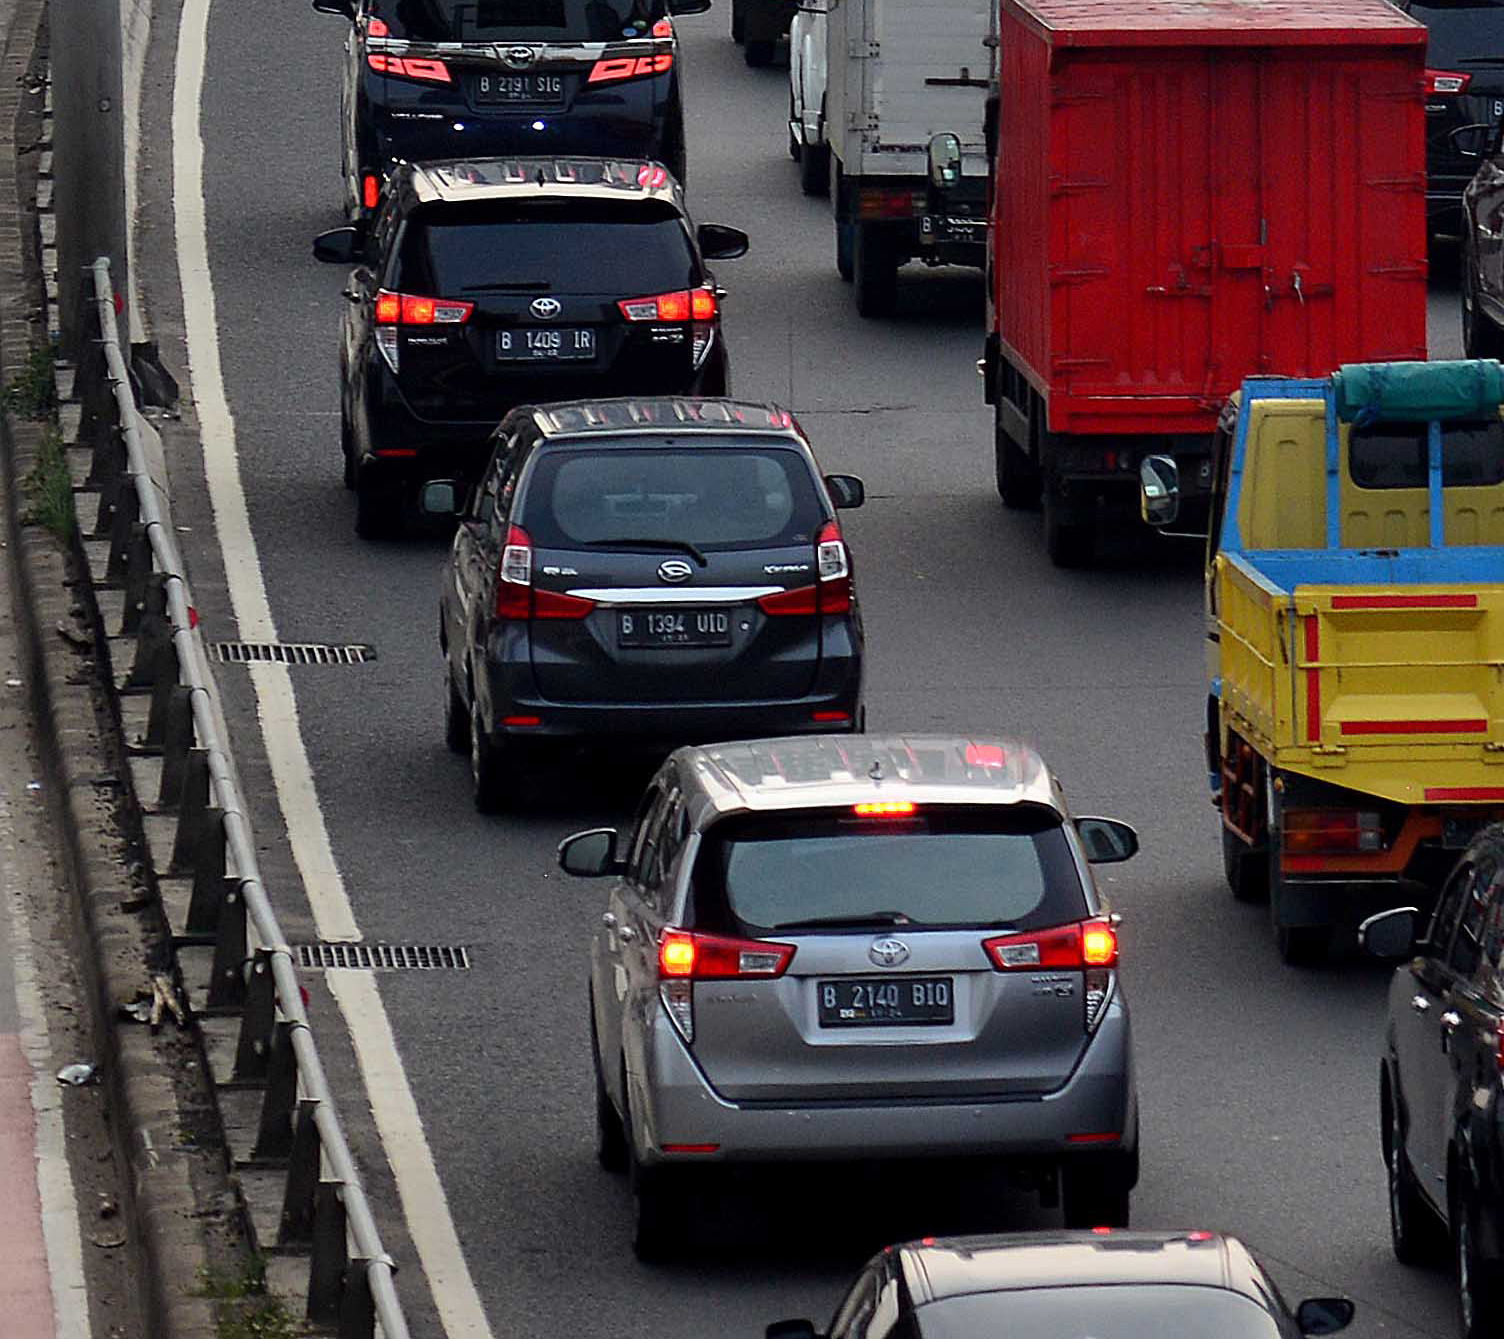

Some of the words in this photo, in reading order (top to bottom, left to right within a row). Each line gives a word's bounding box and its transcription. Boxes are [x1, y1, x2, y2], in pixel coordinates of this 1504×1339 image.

[480, 76, 490, 92] B
[923, 216, 932, 233] B
[501, 331, 512, 349] B
[526, 331, 562, 349] 1409
[574, 331, 590, 348] IR
[622, 614, 634, 634] B
[647, 614, 684, 634] 1394
[697, 613, 729, 634] UID
[823, 985, 837, 1009] B
[852, 984, 899, 1009] 2140
